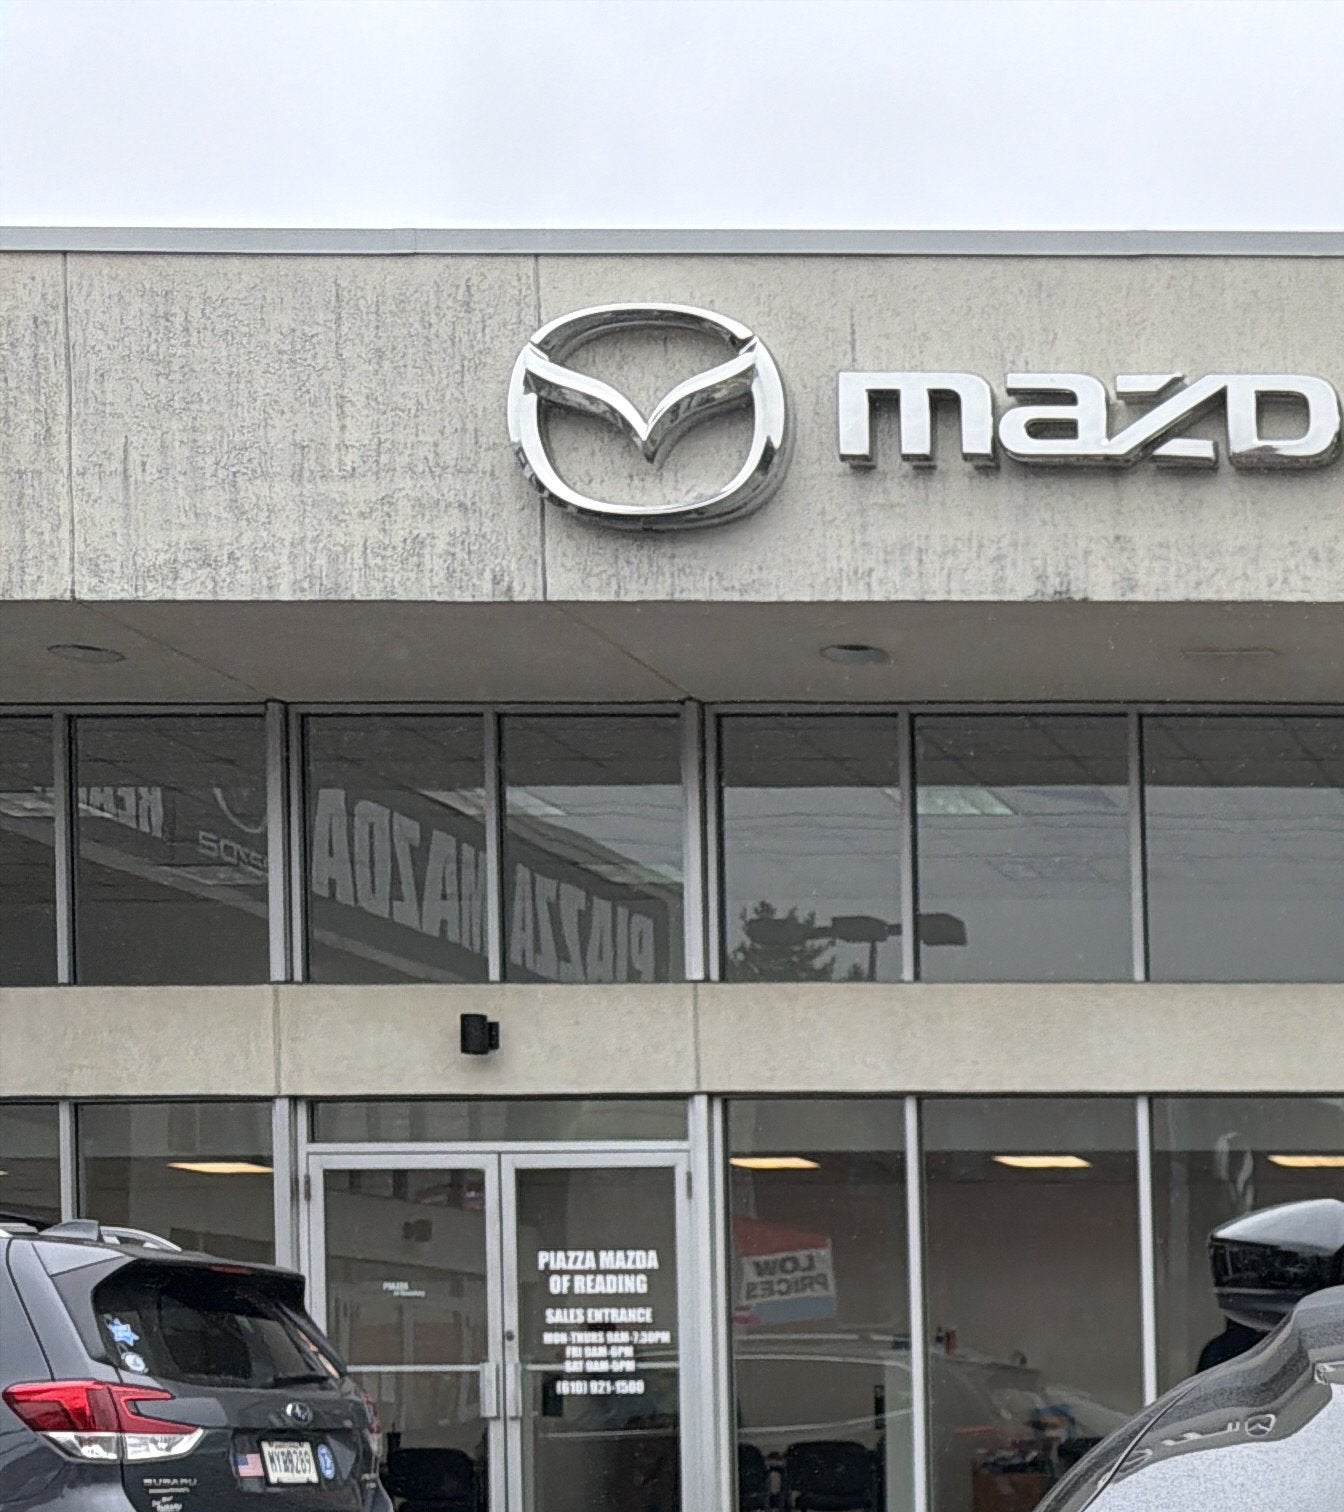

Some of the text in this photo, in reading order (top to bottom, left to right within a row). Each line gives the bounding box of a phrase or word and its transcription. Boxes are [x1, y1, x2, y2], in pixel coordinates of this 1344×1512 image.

[538, 1250, 659, 1270] PIAZZA MAZDA
[550, 1274, 648, 1294] OF READING
[545, 1307, 653, 1324] SALES ENTRANCE
[143, 1478, 197, 1486] SUBARU
